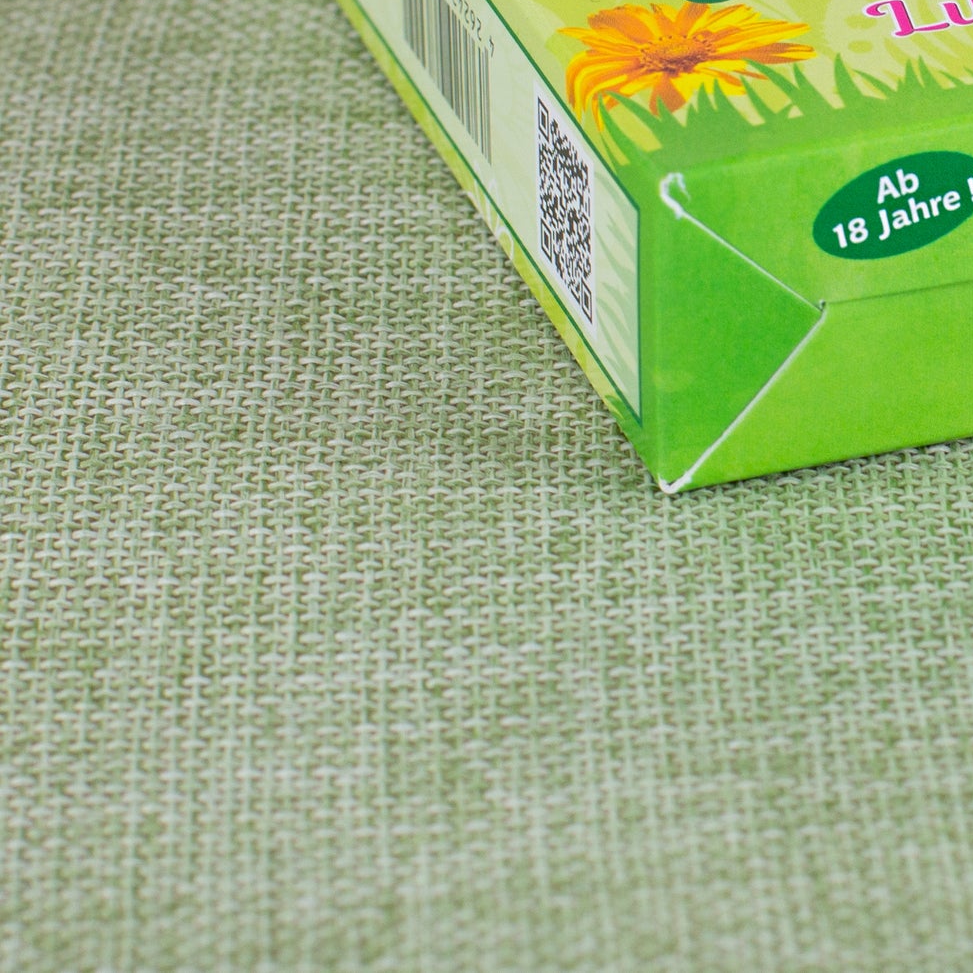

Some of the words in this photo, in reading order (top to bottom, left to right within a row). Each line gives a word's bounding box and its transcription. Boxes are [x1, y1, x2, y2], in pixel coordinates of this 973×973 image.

[876, 168, 921, 205] Ab
[832, 218, 869, 249] 18
[878, 190, 962, 241] Jahre
